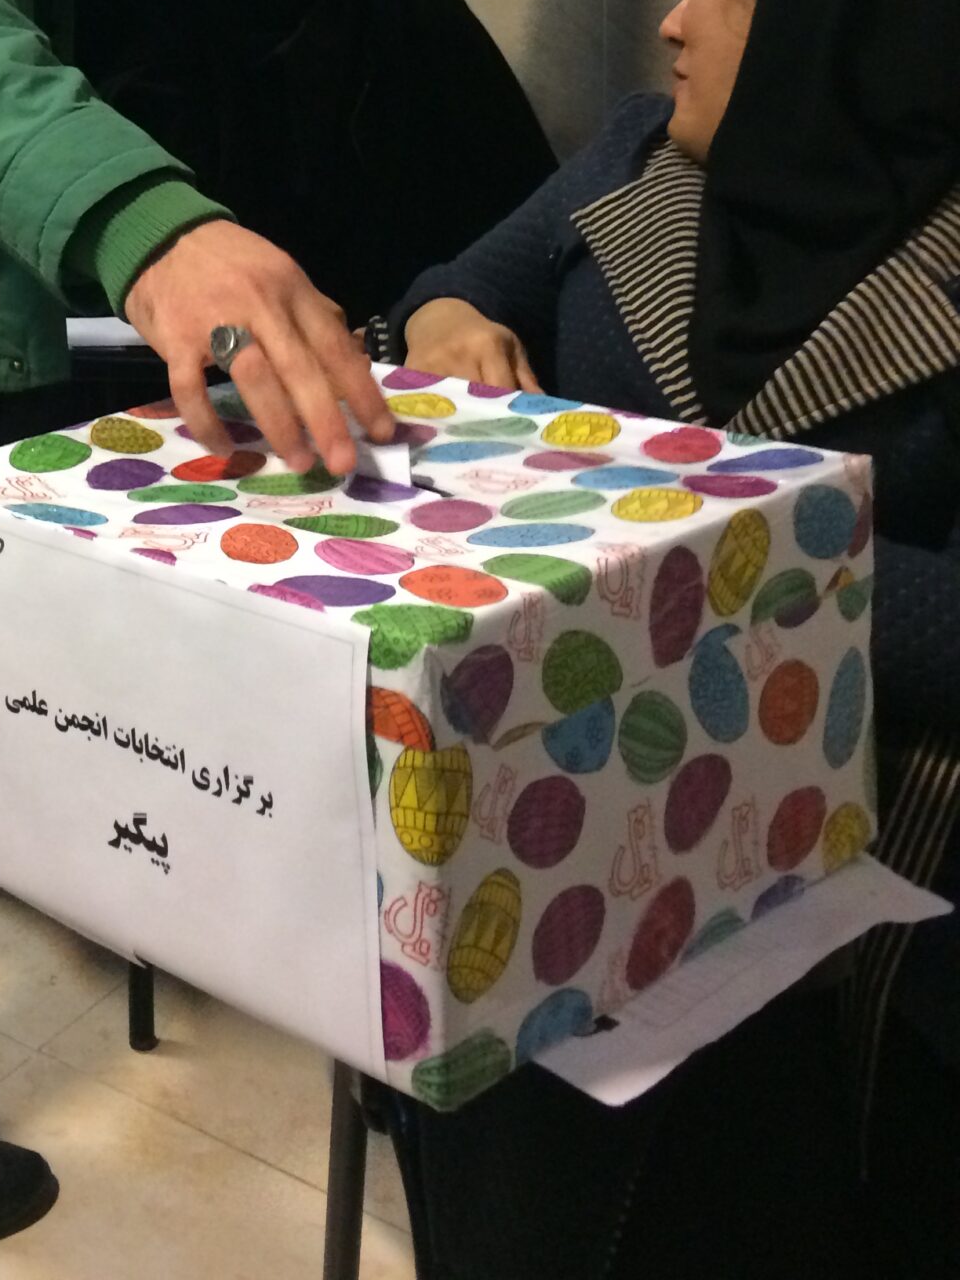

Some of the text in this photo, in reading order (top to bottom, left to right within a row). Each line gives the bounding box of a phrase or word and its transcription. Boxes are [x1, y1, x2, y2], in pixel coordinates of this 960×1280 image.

[4, 689, 49, 717] علمی
[54, 708, 108, 742] انجمن
[113, 726, 186, 774] انتخابات
[107, 812, 172, 876] پیگیر
